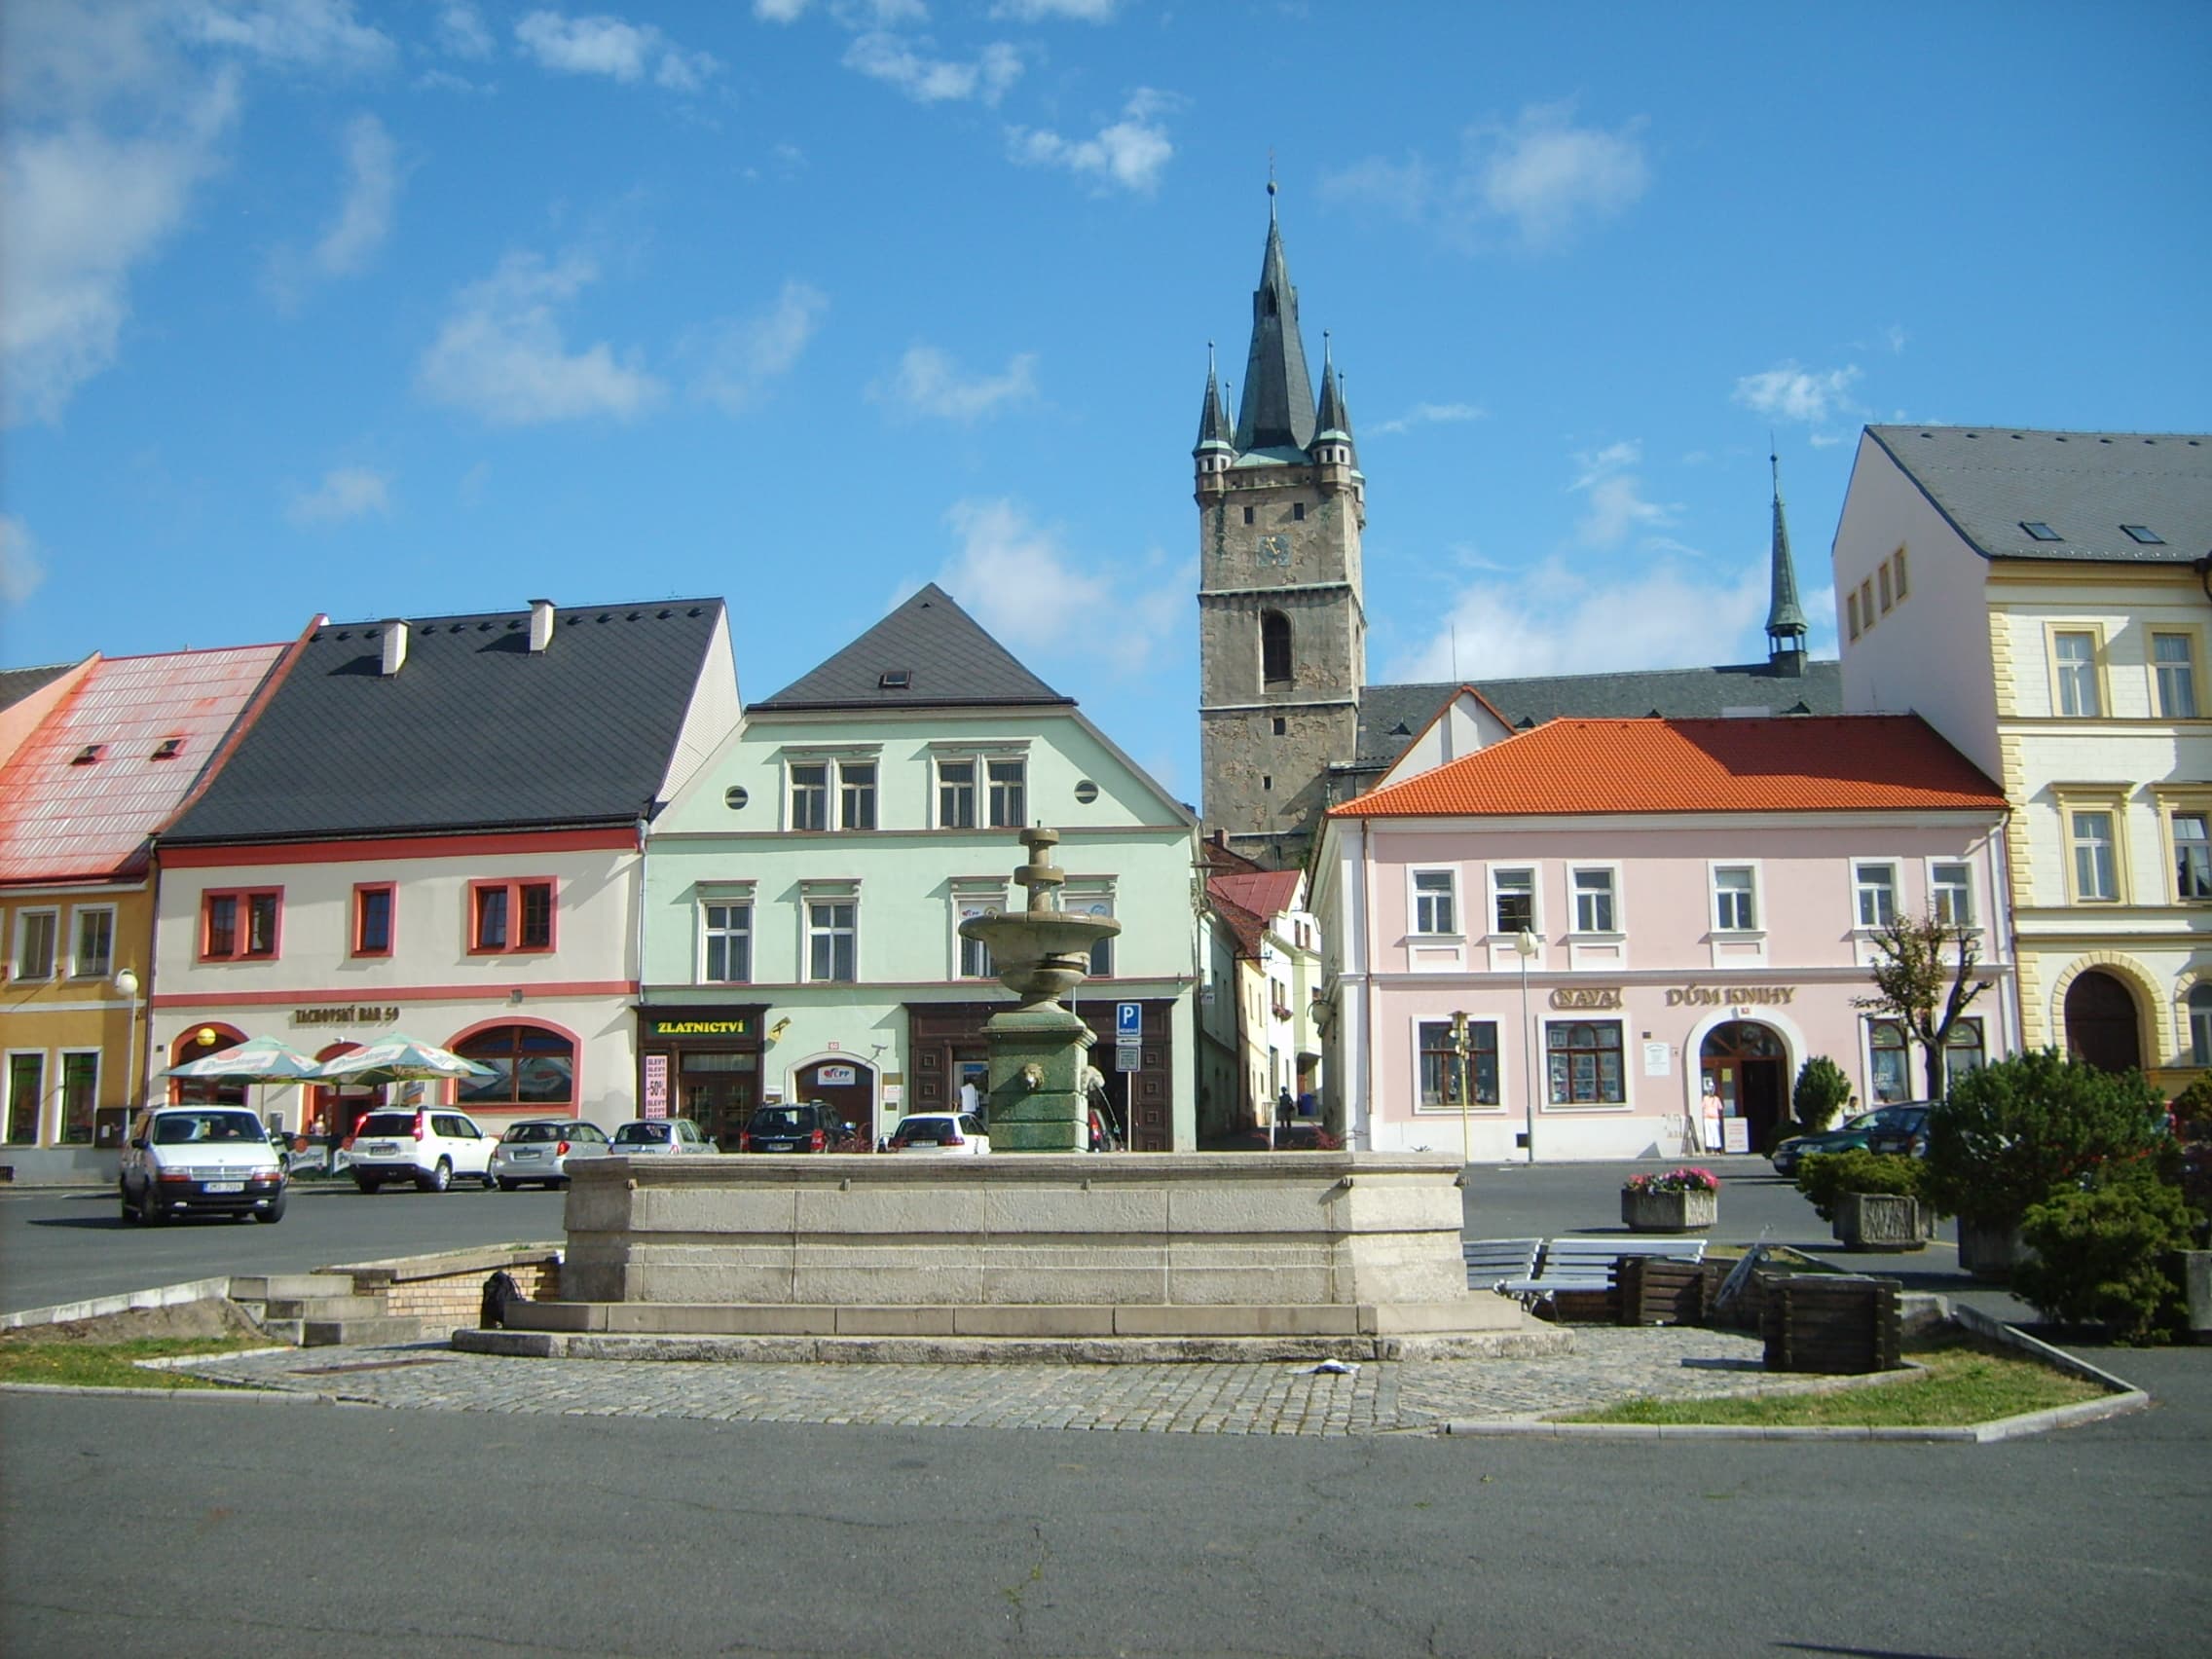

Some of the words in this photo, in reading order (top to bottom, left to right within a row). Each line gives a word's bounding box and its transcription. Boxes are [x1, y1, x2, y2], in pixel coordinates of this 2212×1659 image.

[1559, 988, 1616, 1006] NAVA
[1724, 987, 1795, 1005] KNIHY
[358, 1007, 382, 1021] BAR
[1124, 1007, 1134, 1024] P
[658, 1019, 744, 1033] ZLATNICTVÍ
